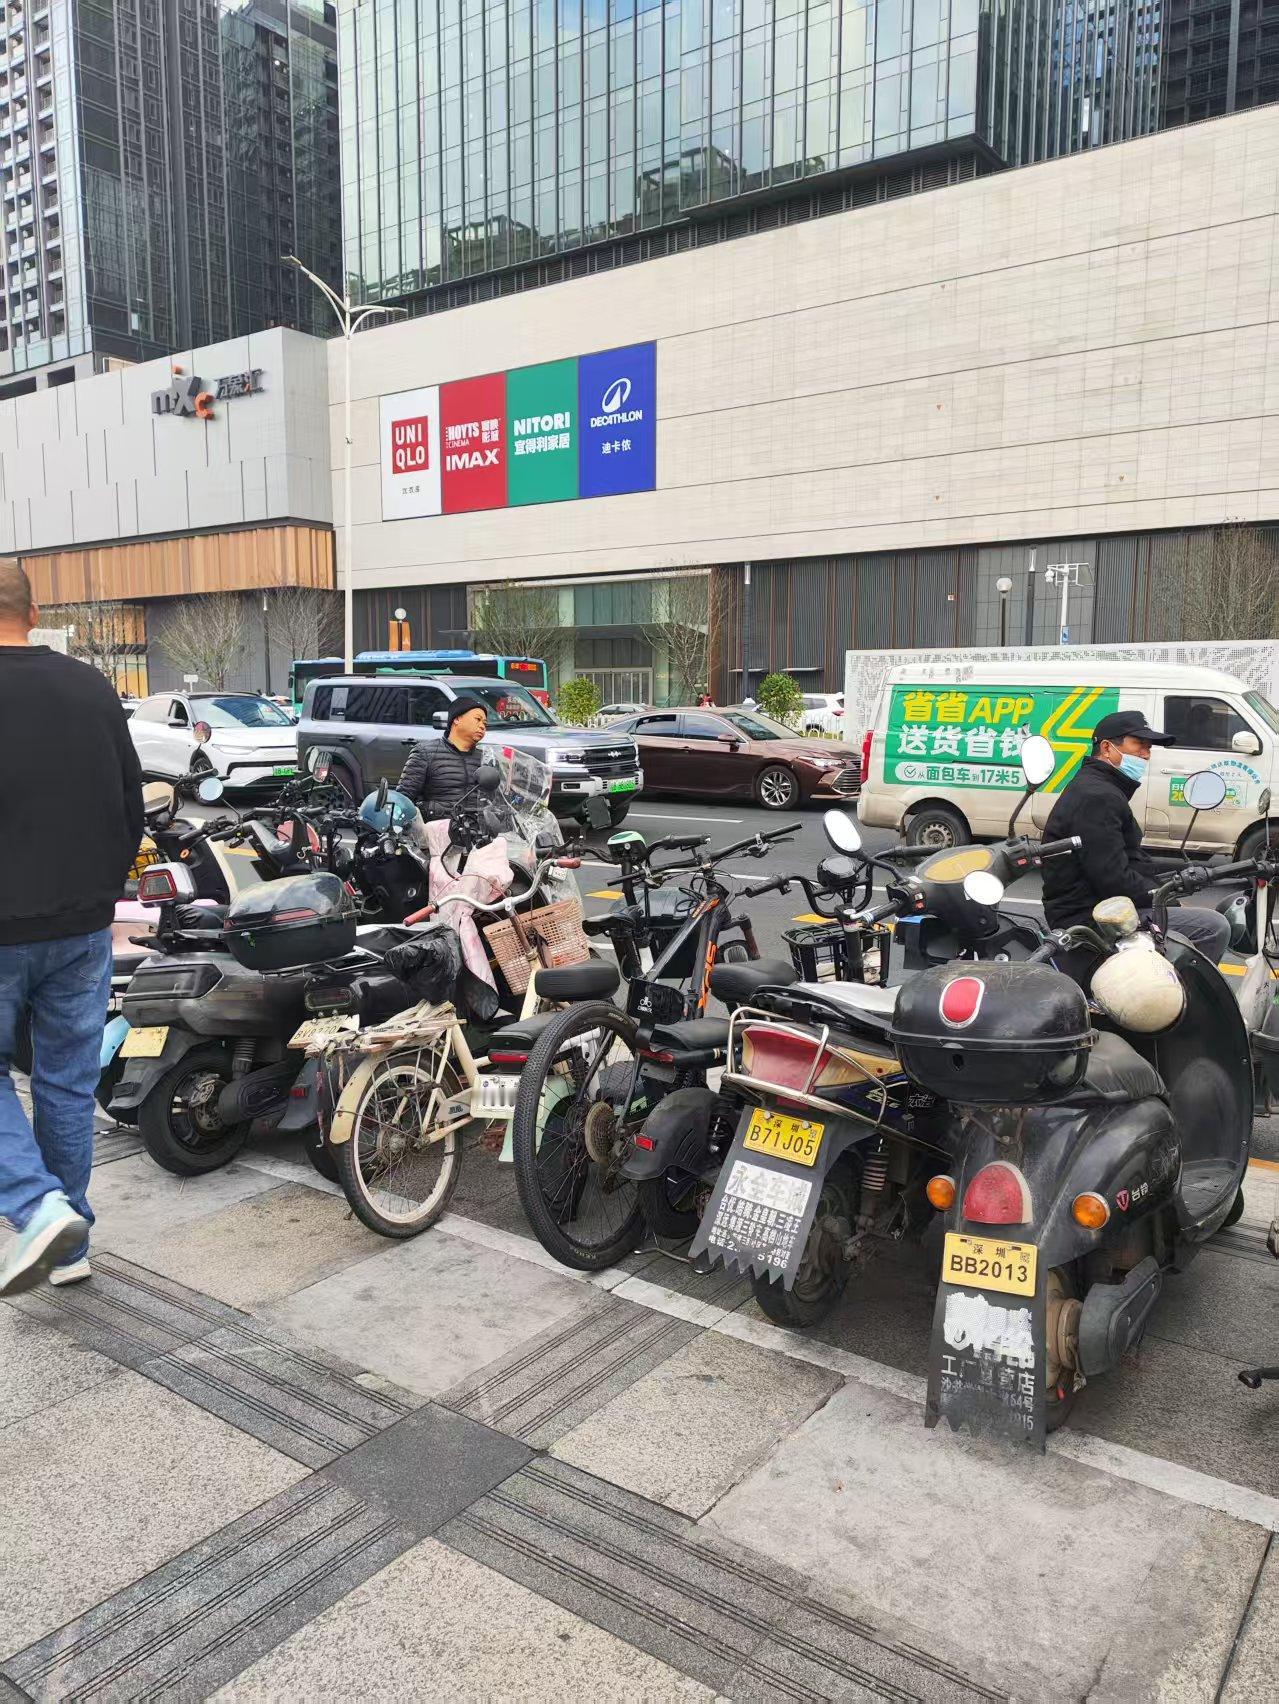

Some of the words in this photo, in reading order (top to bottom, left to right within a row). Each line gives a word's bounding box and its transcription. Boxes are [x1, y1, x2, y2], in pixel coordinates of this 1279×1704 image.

[514, 411, 571, 436] NITORI
[590, 409, 643, 428] DECATHLON
[395, 423, 422, 445] UNI
[446, 421, 480, 441] HOYTS
[514, 433, 570, 455] 宜得利家居
[395, 446, 425, 470] QLO
[446, 448, 499, 471] IMAX
[751, 1125, 816, 1156] B71J05
[974, 1244, 1005, 1258] 深圳
[951, 1254, 1028, 1282] BB2013
